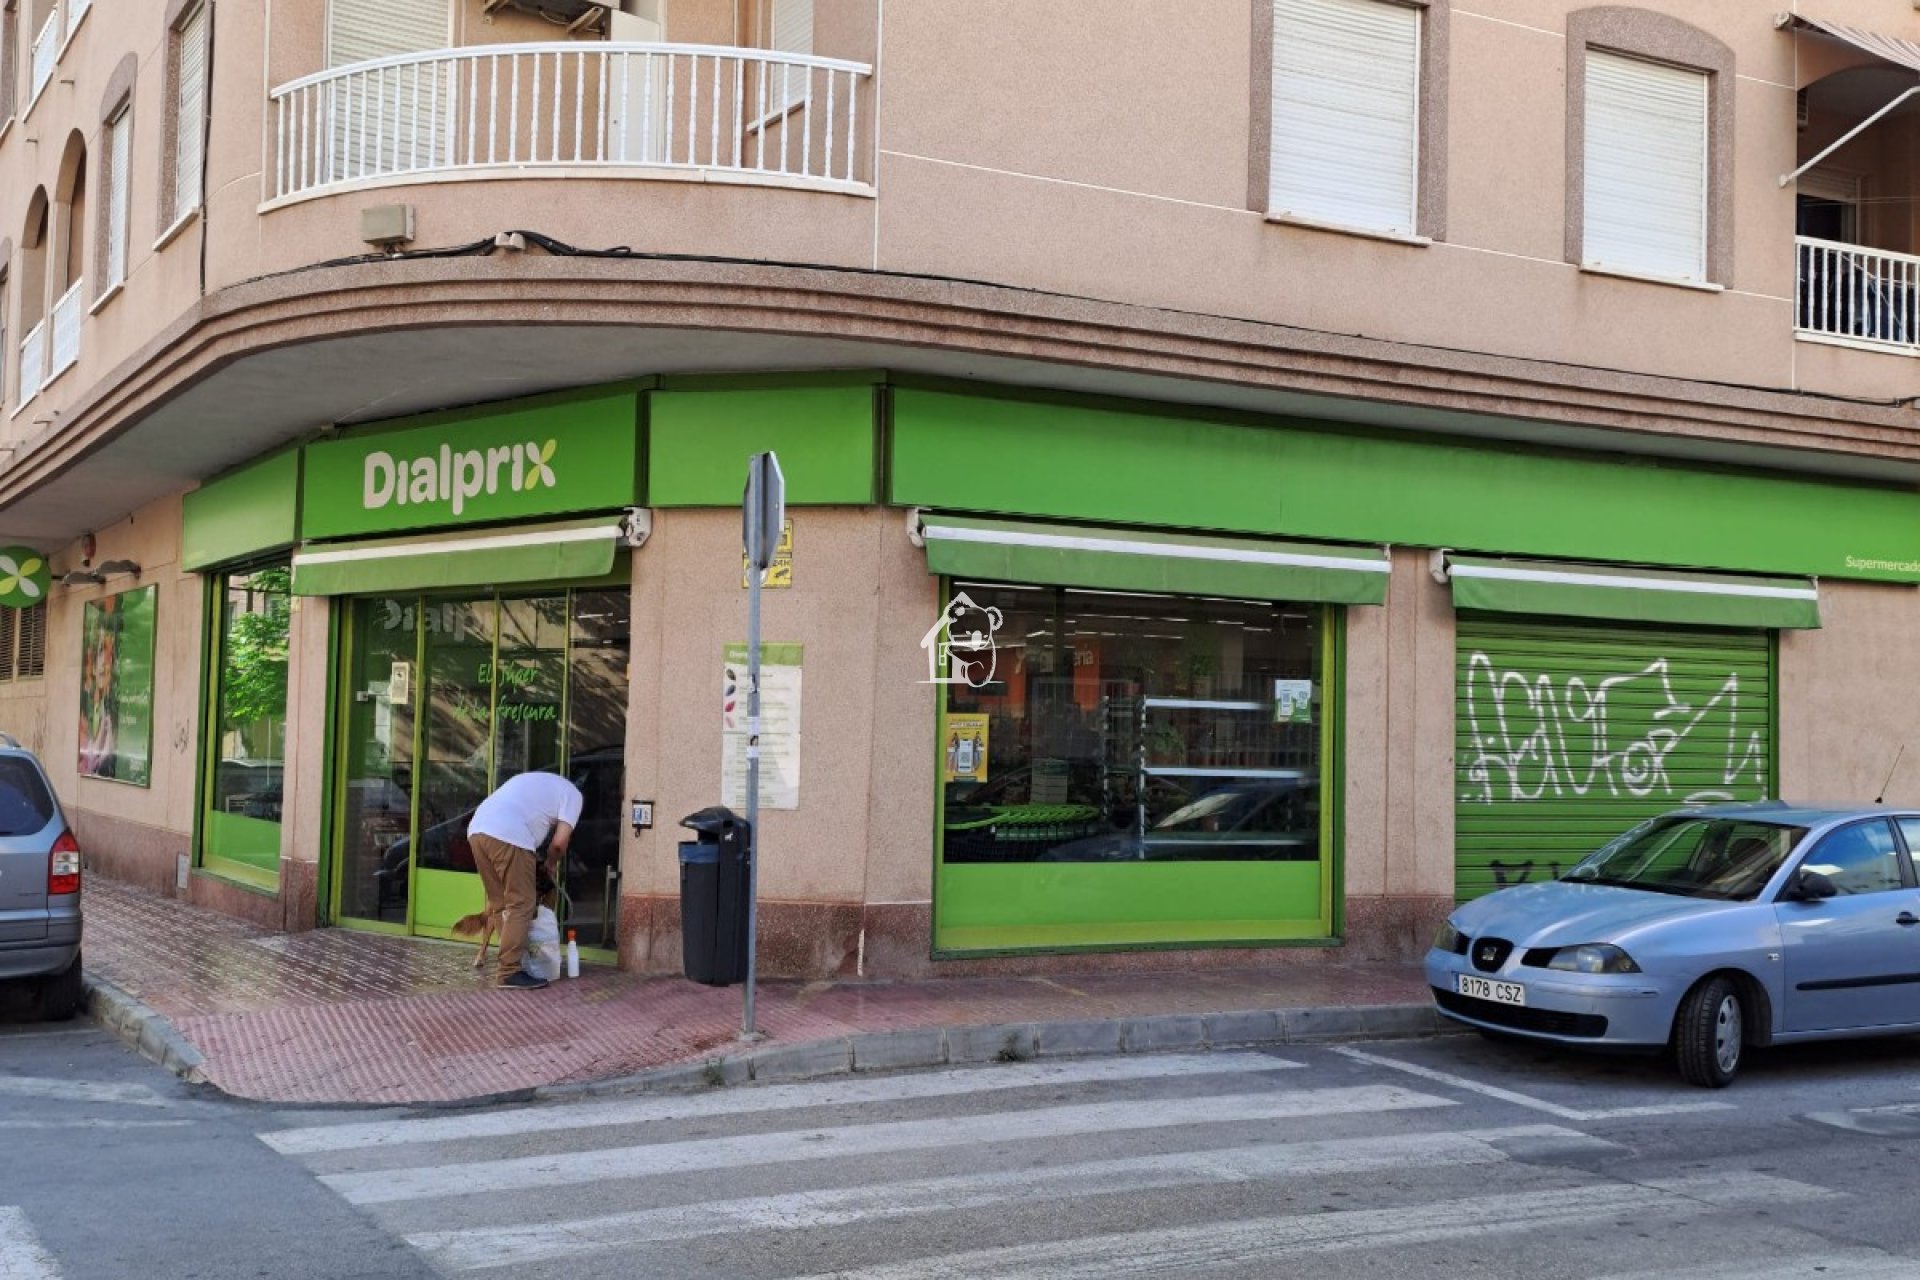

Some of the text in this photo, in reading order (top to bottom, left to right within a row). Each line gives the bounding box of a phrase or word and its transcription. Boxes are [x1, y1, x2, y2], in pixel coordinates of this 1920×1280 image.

[364, 439, 556, 516] Dialprix
[1462, 977, 1521, 1002] 8178 CSZ
